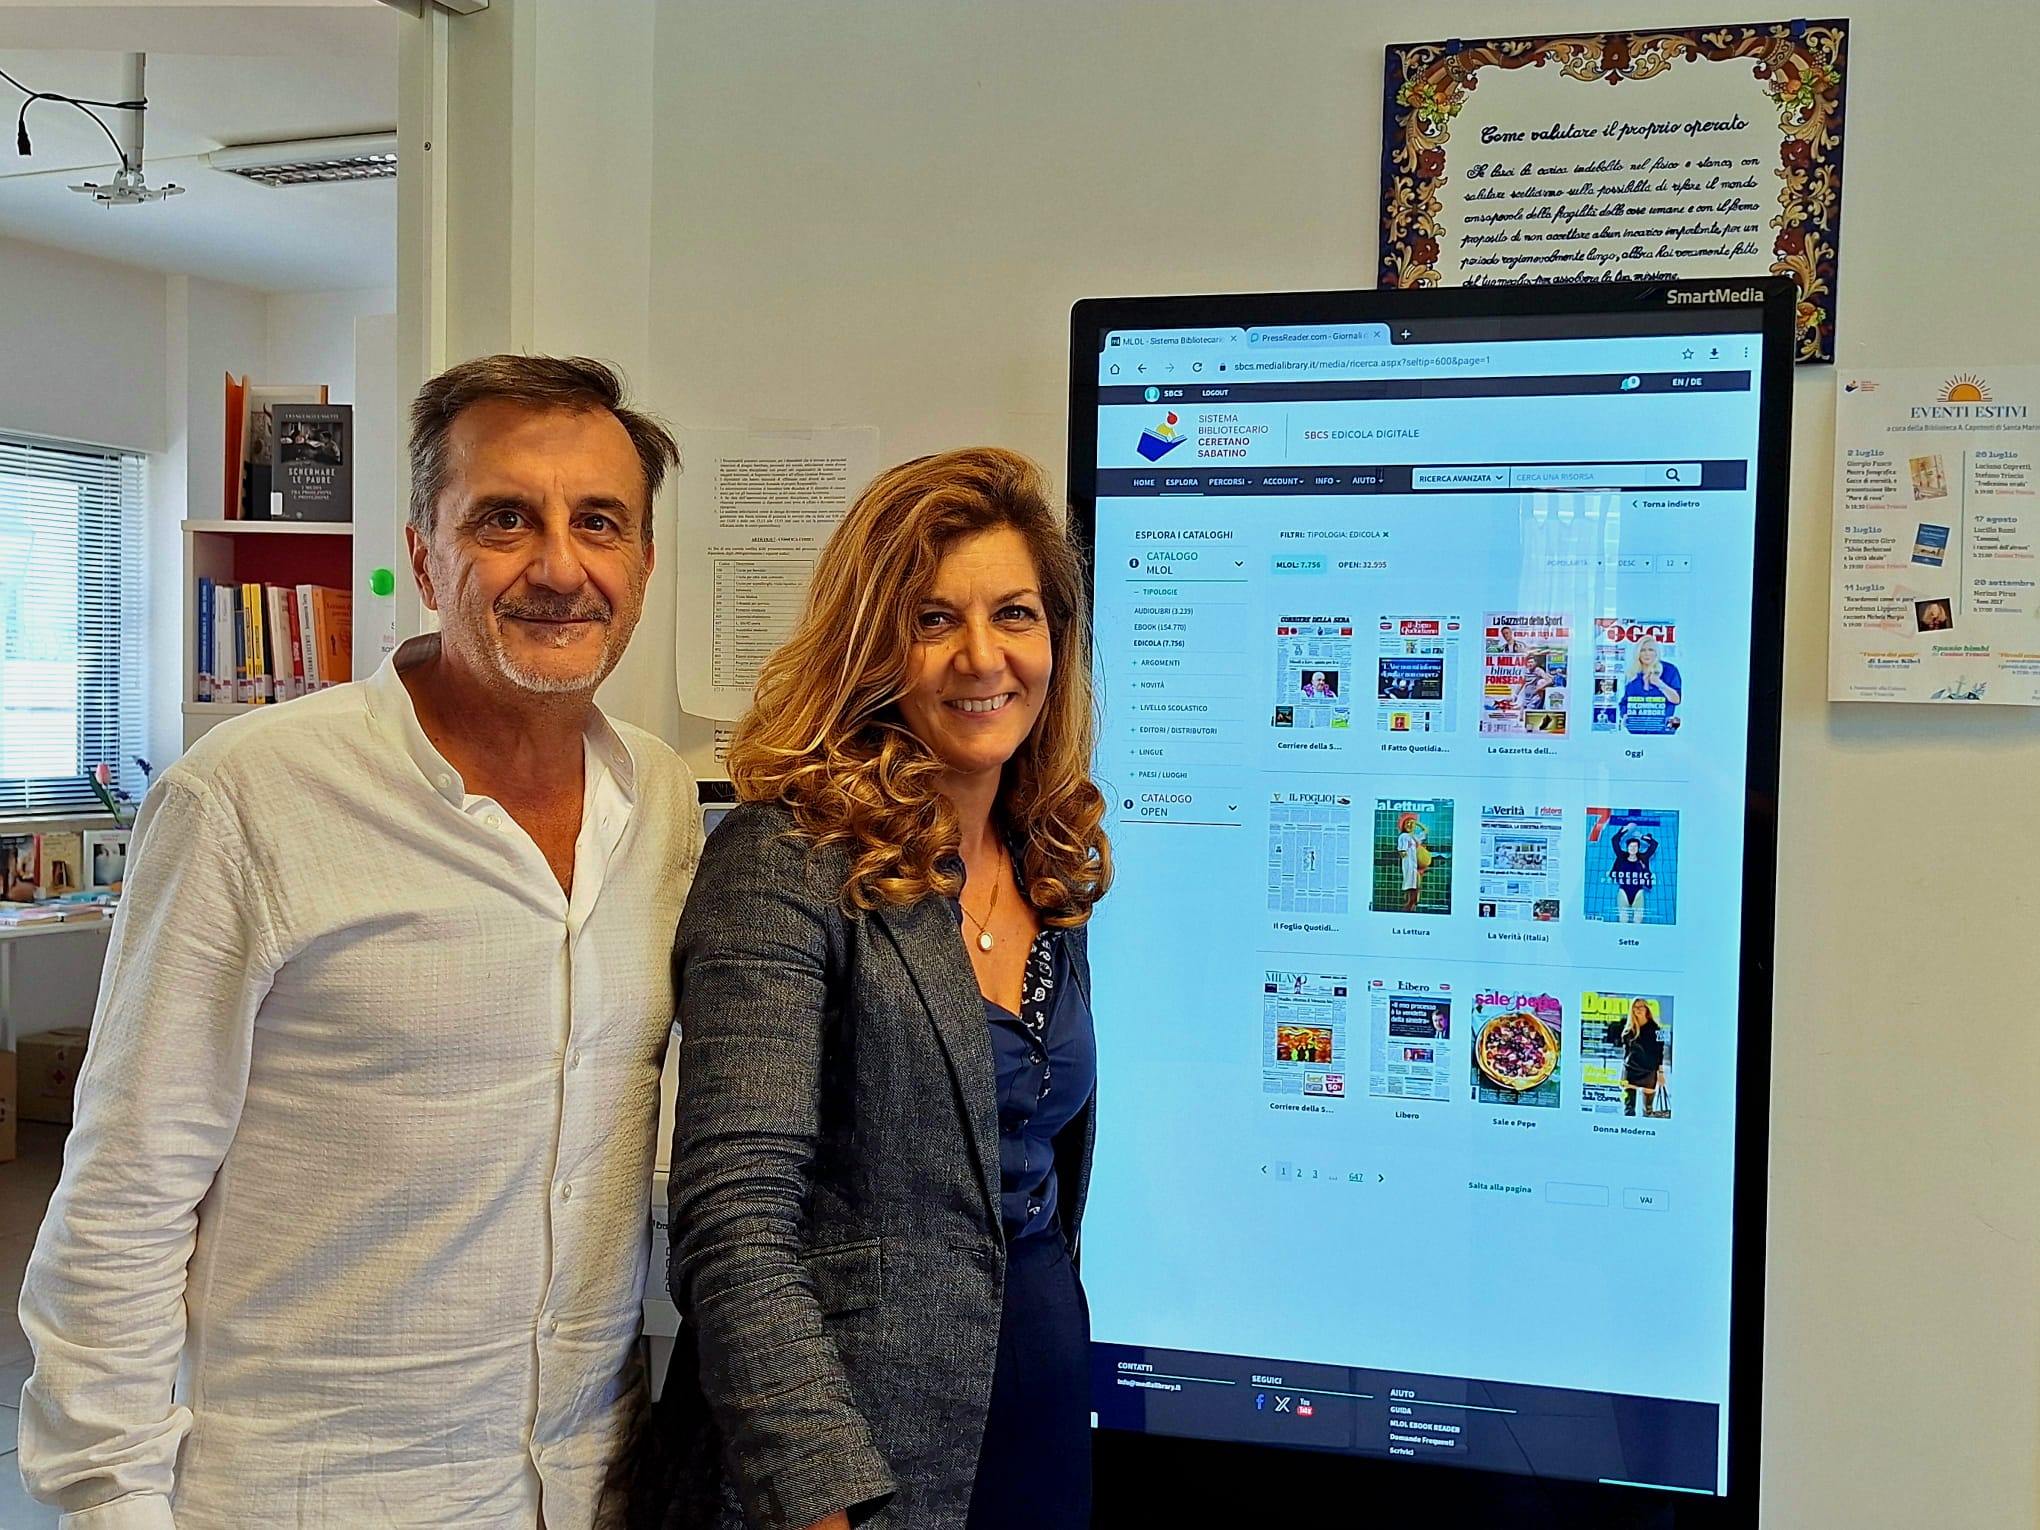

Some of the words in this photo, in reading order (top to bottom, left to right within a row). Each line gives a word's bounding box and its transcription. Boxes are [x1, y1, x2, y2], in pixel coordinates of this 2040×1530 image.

[1481, 126, 1525, 144] Come
[1531, 123, 1597, 140] valutare
[1603, 121, 1618, 137] il
[1618, 121, 1682, 141] proprio
[1684, 114, 1749, 137] operato
[1574, 160, 1624, 173] indebolito
[1630, 158, 1650, 170] nel
[1649, 157, 1679, 173] fisico
[1464, 188, 1505, 201] salutare
[1567, 183, 1594, 196] sulla
[1655, 179, 1668, 191] di
[1705, 177, 1719, 189] il
[1721, 176, 1758, 189] mondo
[1688, 205, 1695, 213] e
[1717, 199, 1731, 211] il
[1511, 229, 1521, 241] di
[1743, 224, 1758, 232] un
[1667, 289, 1764, 304] SmartMedia
[1150, 336, 1178, 345] Sistema
[1262, 332, 1330, 342] PressReader.com
[1672, 378, 1684, 386] EN
[1164, 389, 1183, 397] SBCS
[1911, 407, 1969, 418] EVENTI
[1976, 406, 2027, 418] ESTIVI
[1199, 414, 1238, 423] SISTEMA
[1199, 424, 1268, 434] BIBLIOTECARIO
[1304, 431, 1329, 439] SBCS
[1331, 430, 1373, 439] EDICOLA
[1377, 429, 1419, 438] DIGITALE
[1199, 437, 1250, 446] CERETANO
[1198, 449, 1246, 457] SABATINO
[1989, 451, 2018, 459] luglio
[1209, 478, 1245, 486] PERCORSI
[1263, 477, 1299, 485] ACCOUNT
[1352, 476, 1376, 484] AIUTO
[1419, 475, 1451, 483] RICERCA
[1453, 474, 1491, 482] AVANZATA
[1643, 501, 1665, 509] Torna
[1668, 500, 1700, 509] indietro
[1136, 531, 1176, 539] ESPLORA
[1183, 531, 1233, 539] CATALOGHI
[1147, 552, 1198, 561] CATALOGO
[1147, 566, 1173, 575] MLOL
[1278, 742, 1307, 750] Corriere
[1625, 750, 1644, 758] Oggi
[1141, 794, 1192, 803] CATALOGO
[1141, 808, 1168, 816] OPEN
[1587, 808, 1611, 842] 7
[1280, 923, 1302, 931] Foglio
[1499, 933, 1521, 941] Verità
[1523, 933, 1549, 942] (Italia)
[1270, 1103, 1300, 1111] Corriere
[1302, 1104, 1319, 1112] della
[1517, 1120, 1536, 1128] Pepe
[1594, 1126, 1618, 1134] Donna
[1621, 1128, 1656, 1136] Moderna
[1297, 1169, 1302, 1177] 2
[1313, 1170, 1318, 1179] 3
[1468, 1182, 1488, 1191] Salta
[1490, 1184, 1504, 1192] alla
[1506, 1185, 1532, 1195] pagina
[1640, 1196, 1652, 1204] VAI
[1118, 1362, 1152, 1372] CONTATTI
[1252, 1375, 1282, 1384] SEGUICI
[1390, 1389, 1415, 1398] AIUTO
[1390, 1406, 1412, 1415] GUIDA
